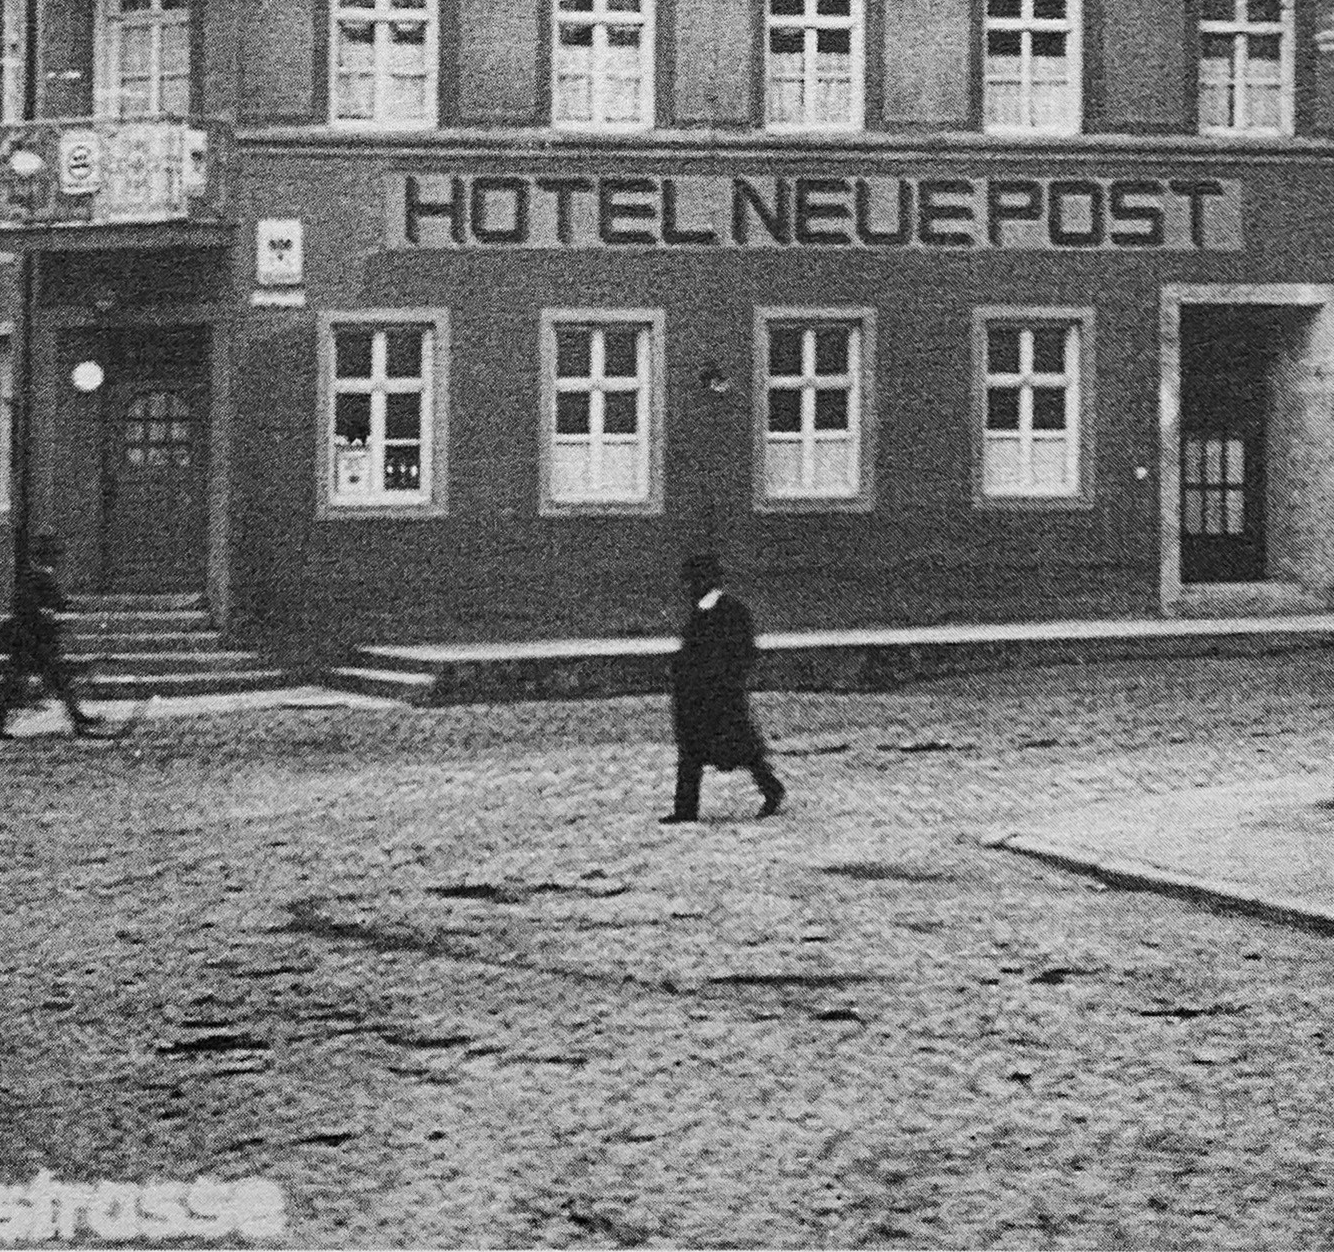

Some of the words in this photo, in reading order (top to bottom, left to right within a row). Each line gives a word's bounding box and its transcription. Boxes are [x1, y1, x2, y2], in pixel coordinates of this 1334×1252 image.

[404, 175, 719, 246] HOTEL
[731, 178, 974, 247] NEUE
[987, 178, 1224, 248] POST
